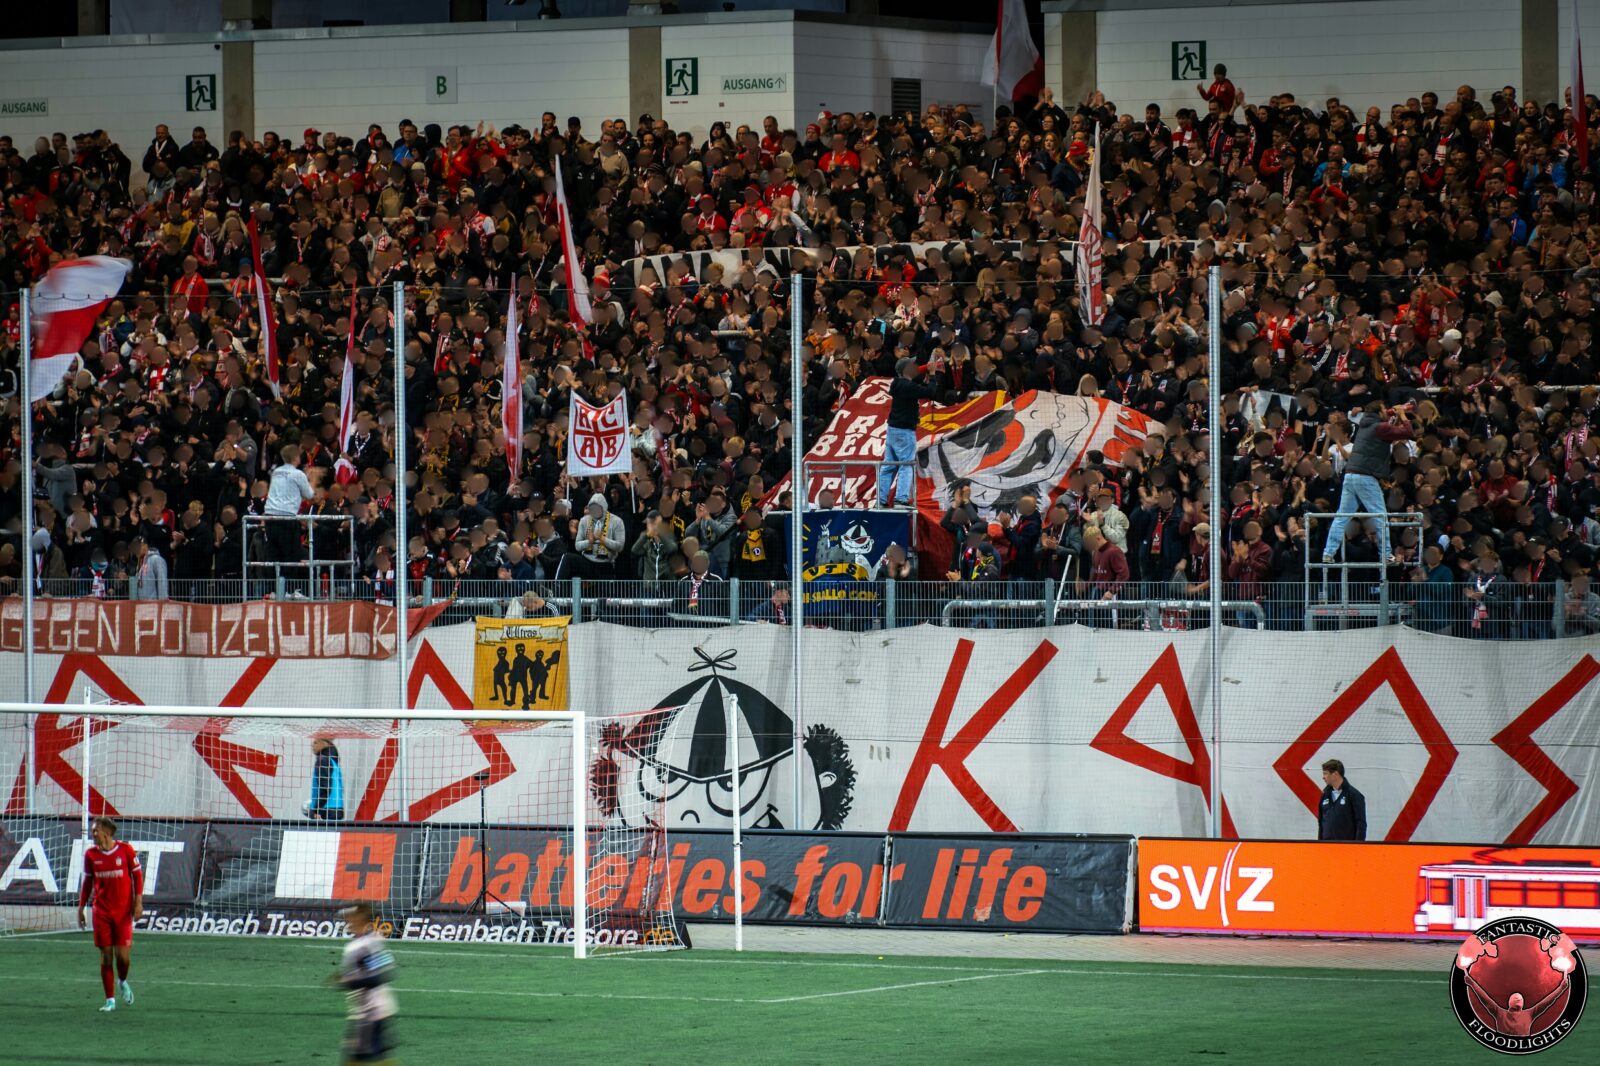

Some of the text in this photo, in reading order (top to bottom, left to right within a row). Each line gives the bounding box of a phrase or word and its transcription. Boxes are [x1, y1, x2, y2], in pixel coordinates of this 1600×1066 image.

[436, 75, 447, 95] B
[723, 78, 774, 91] AUSGANG
[1, 102, 46, 114] AUSGANG
[1, 601, 120, 654] GEGEN
[439, 836, 1047, 922] batteries for life
[132, 910, 259, 935] Eisenbach
[401, 917, 535, 943] Eisenbach
